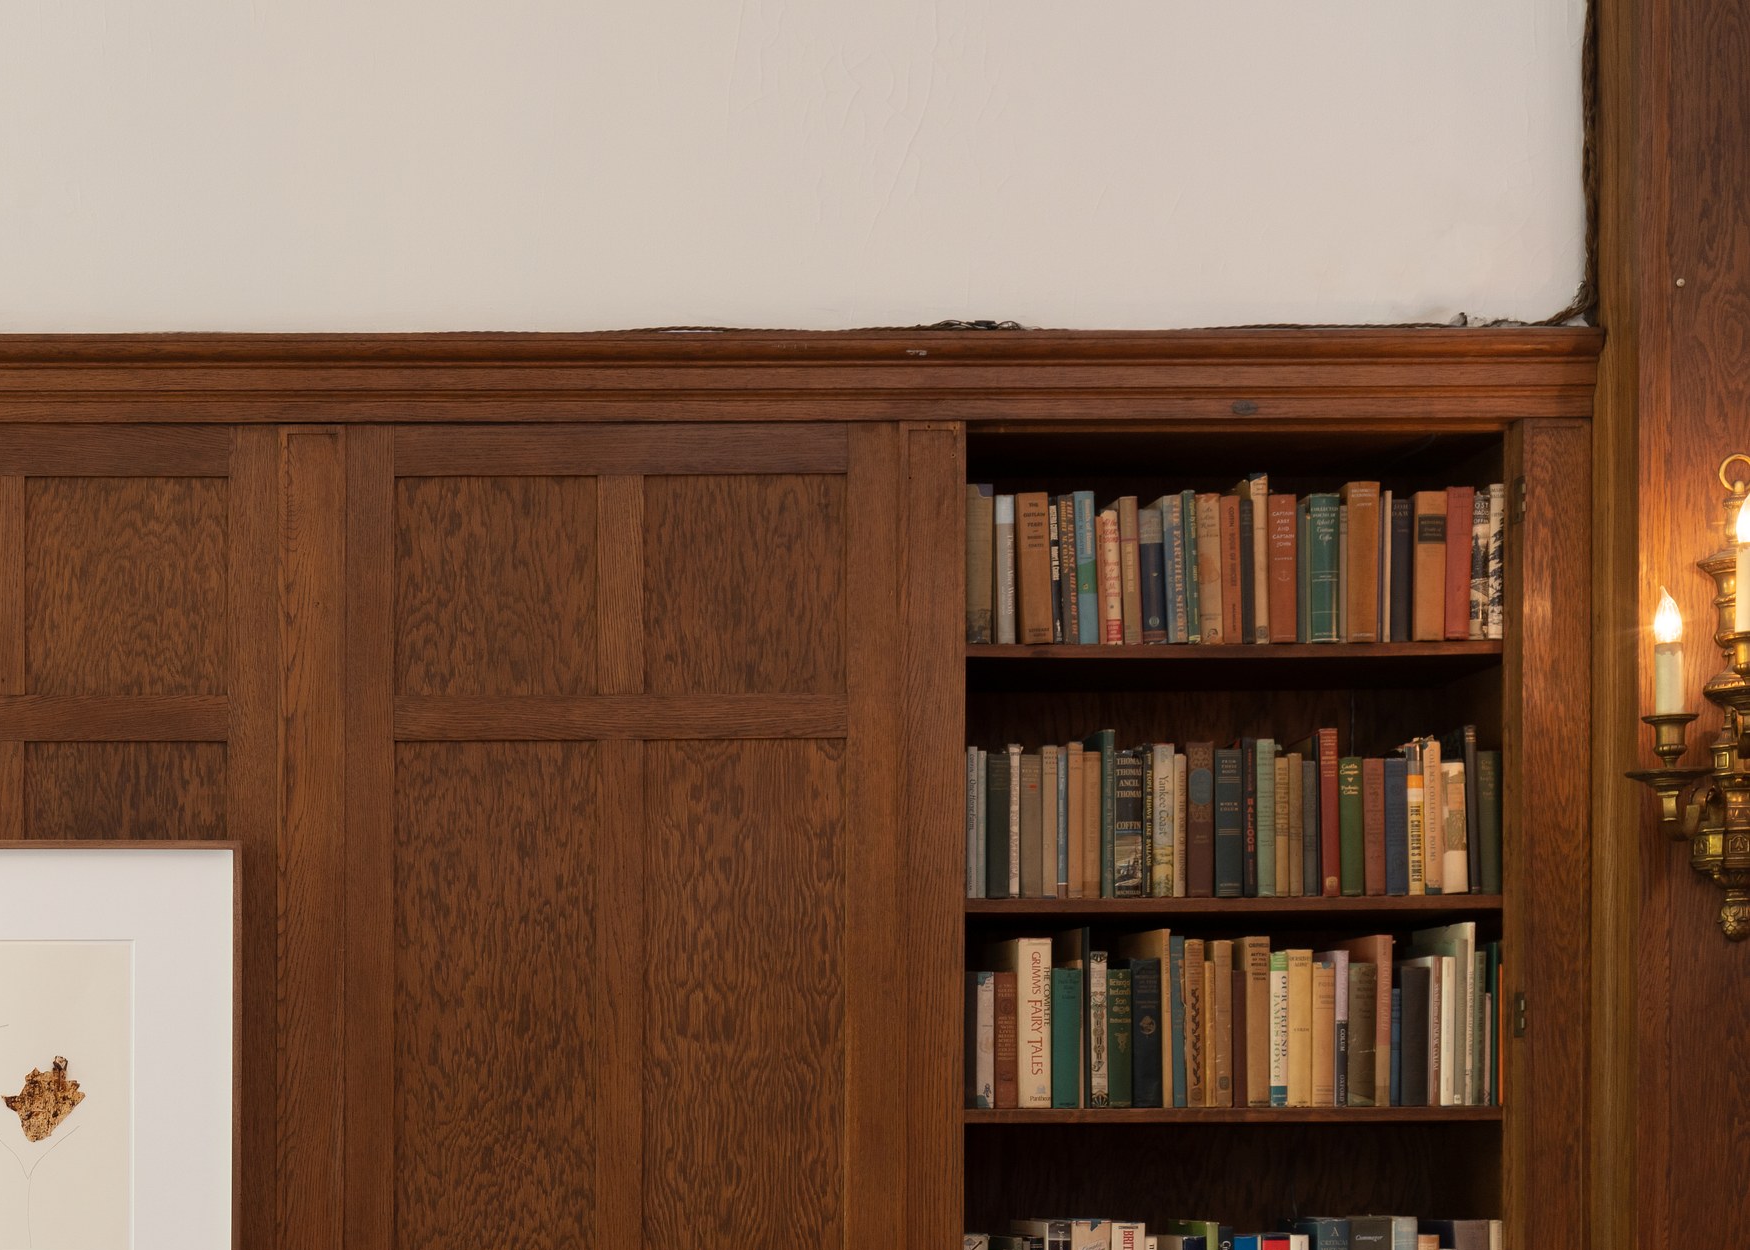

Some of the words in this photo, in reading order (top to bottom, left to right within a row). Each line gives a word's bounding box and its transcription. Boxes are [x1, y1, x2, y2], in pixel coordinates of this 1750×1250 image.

[1159, 776, 1169, 808] Yankee
[1159, 810, 1169, 835] Coast
[1411, 806, 1421, 816] THE
[1411, 820, 1421, 856] CHILDREN'S
[1411, 860, 1422, 882] HOMER
[1027, 999, 1042, 1033] FAIRY
[1027, 1037, 1042, 1075] TALES
